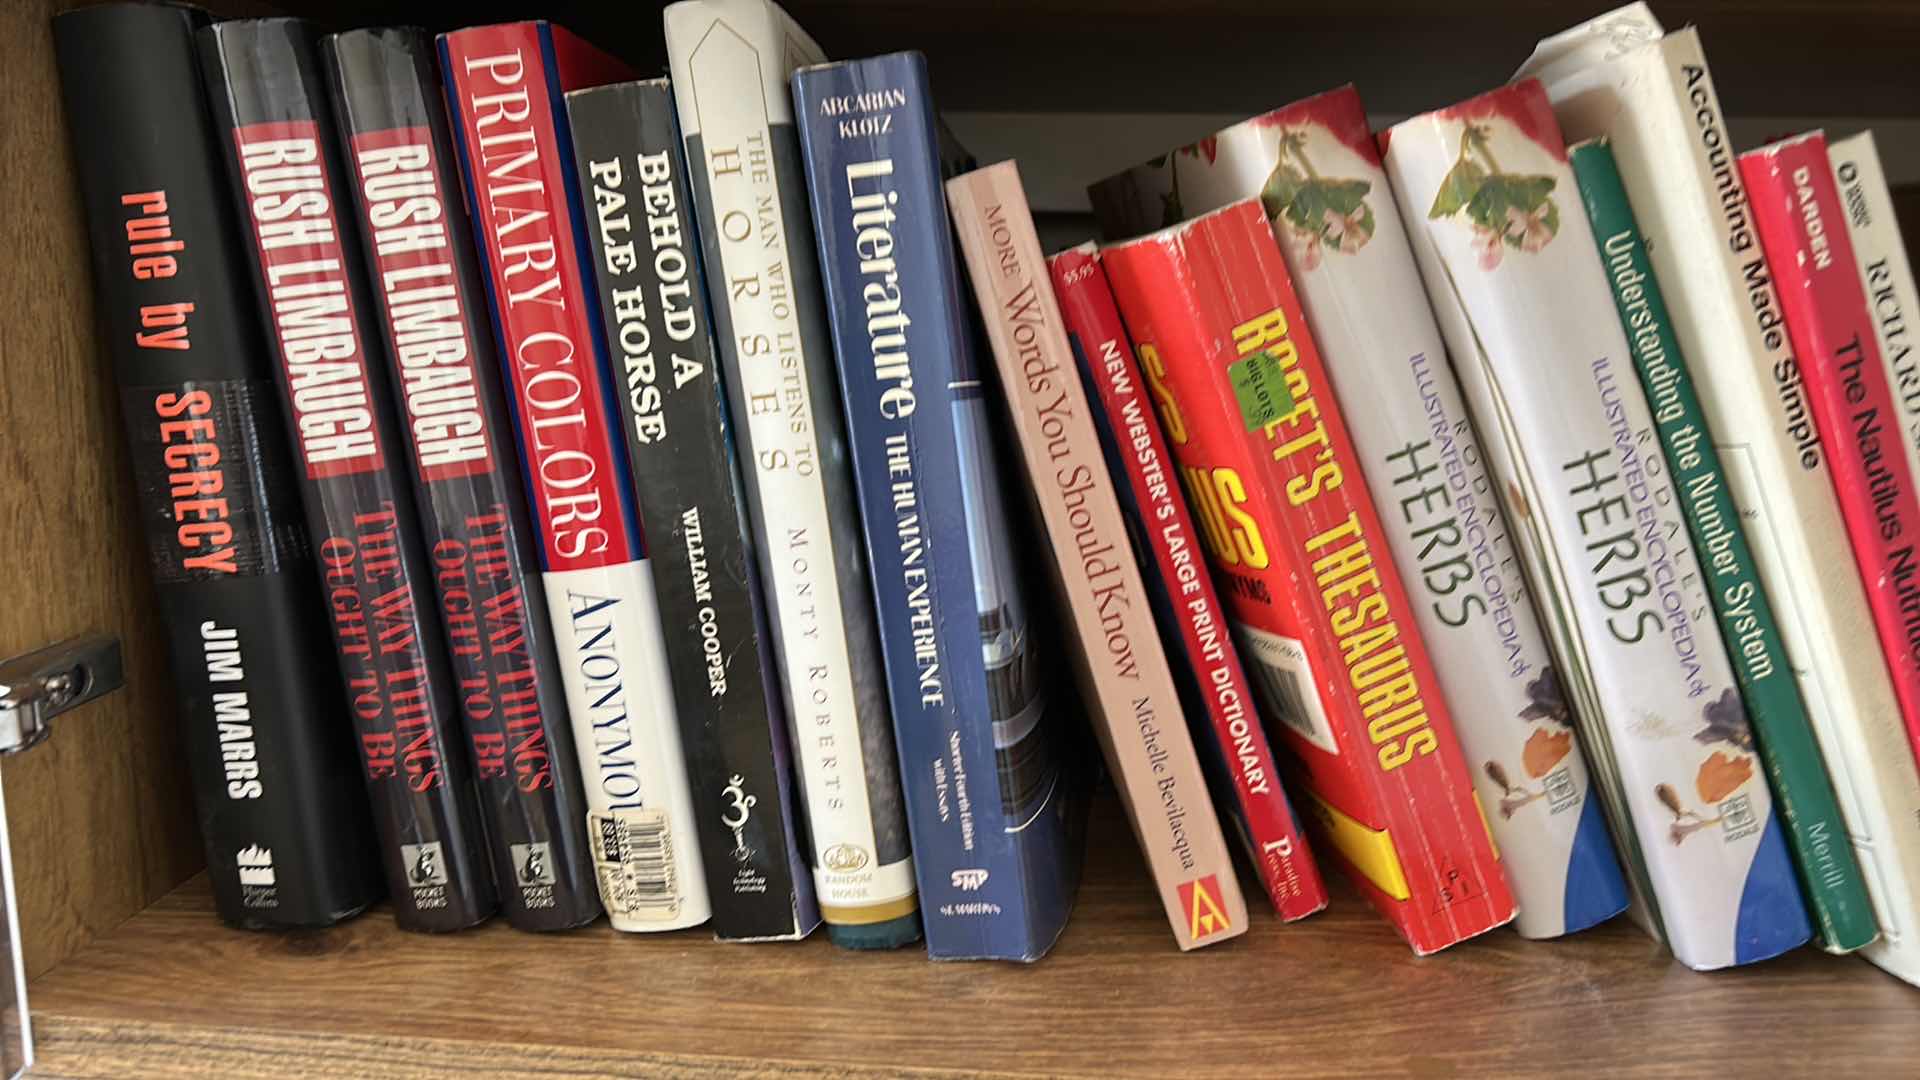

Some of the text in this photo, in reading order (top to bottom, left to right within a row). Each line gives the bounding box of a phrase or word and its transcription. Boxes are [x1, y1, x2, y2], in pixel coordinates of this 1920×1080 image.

[819, 88, 906, 117] ABCARIAN
[1792, 166, 1833, 271] DARDEN
[121, 190, 195, 351] rule by
[241, 138, 377, 464] RUSH LIMBAUGH
[358, 144, 488, 467] RUSH LIMBAUGH
[464, 48, 609, 560] PRIMARY COLORS
[589, 156, 668, 444] PALE HORSE
[637, 150, 704, 389] BEHOLD A
[710, 147, 788, 470] HORSES
[746, 130, 814, 477] THE MAN WHO LISTENS TO
[1682, 62, 1819, 473] Accounting Made Simple
[155, 390, 237, 574] SECRECY
[846, 158, 945, 711] Literature THE HUMAN EXPERIENCE
[984, 202, 1143, 682] MORE Words You Should Know
[1386, 438, 1488, 628] HERBS
[1409, 352, 1532, 679] ILLUSTRATED ENCYCLOPEDIA of
[1454, 417, 1524, 605] RODALE'S
[1563, 448, 1664, 645] HERBS
[1591, 357, 1712, 699] ILLUSTRATED ENCYCLOPEDIA of
[1603, 229, 1775, 682] Understanding the Number System
[1636, 426, 1707, 624] RODALE'S
[1835, 332, 1867, 404] The
[1853, 408, 1902, 542] Nautilus
[320, 537, 397, 779] OUGHT TO BE
[354, 500, 445, 793] THE WAY THINGS
[433, 539, 508, 779] OUGHT TO BE
[465, 504, 553, 793] THE WAY THINGS
[682, 506, 726, 697] WILLIAM COOPER
[787, 527, 844, 810] MONTY ROBERTS
[1099, 339, 1134, 396] NEW
[1121, 397, 1176, 520] WEBSTER'S
[1163, 520, 1201, 596] LARGE
[1187, 597, 1225, 664] PRINT
[1210, 663, 1271, 798] DICTIONARY
[1304, 510, 1438, 771] THESAURUS
[200, 621, 263, 800] JIM MARRS
[566, 588, 643, 811] ANONYMO
[1131, 695, 1195, 873] Michelle Bevilacqua
[1807, 821, 1845, 889] Merrill
